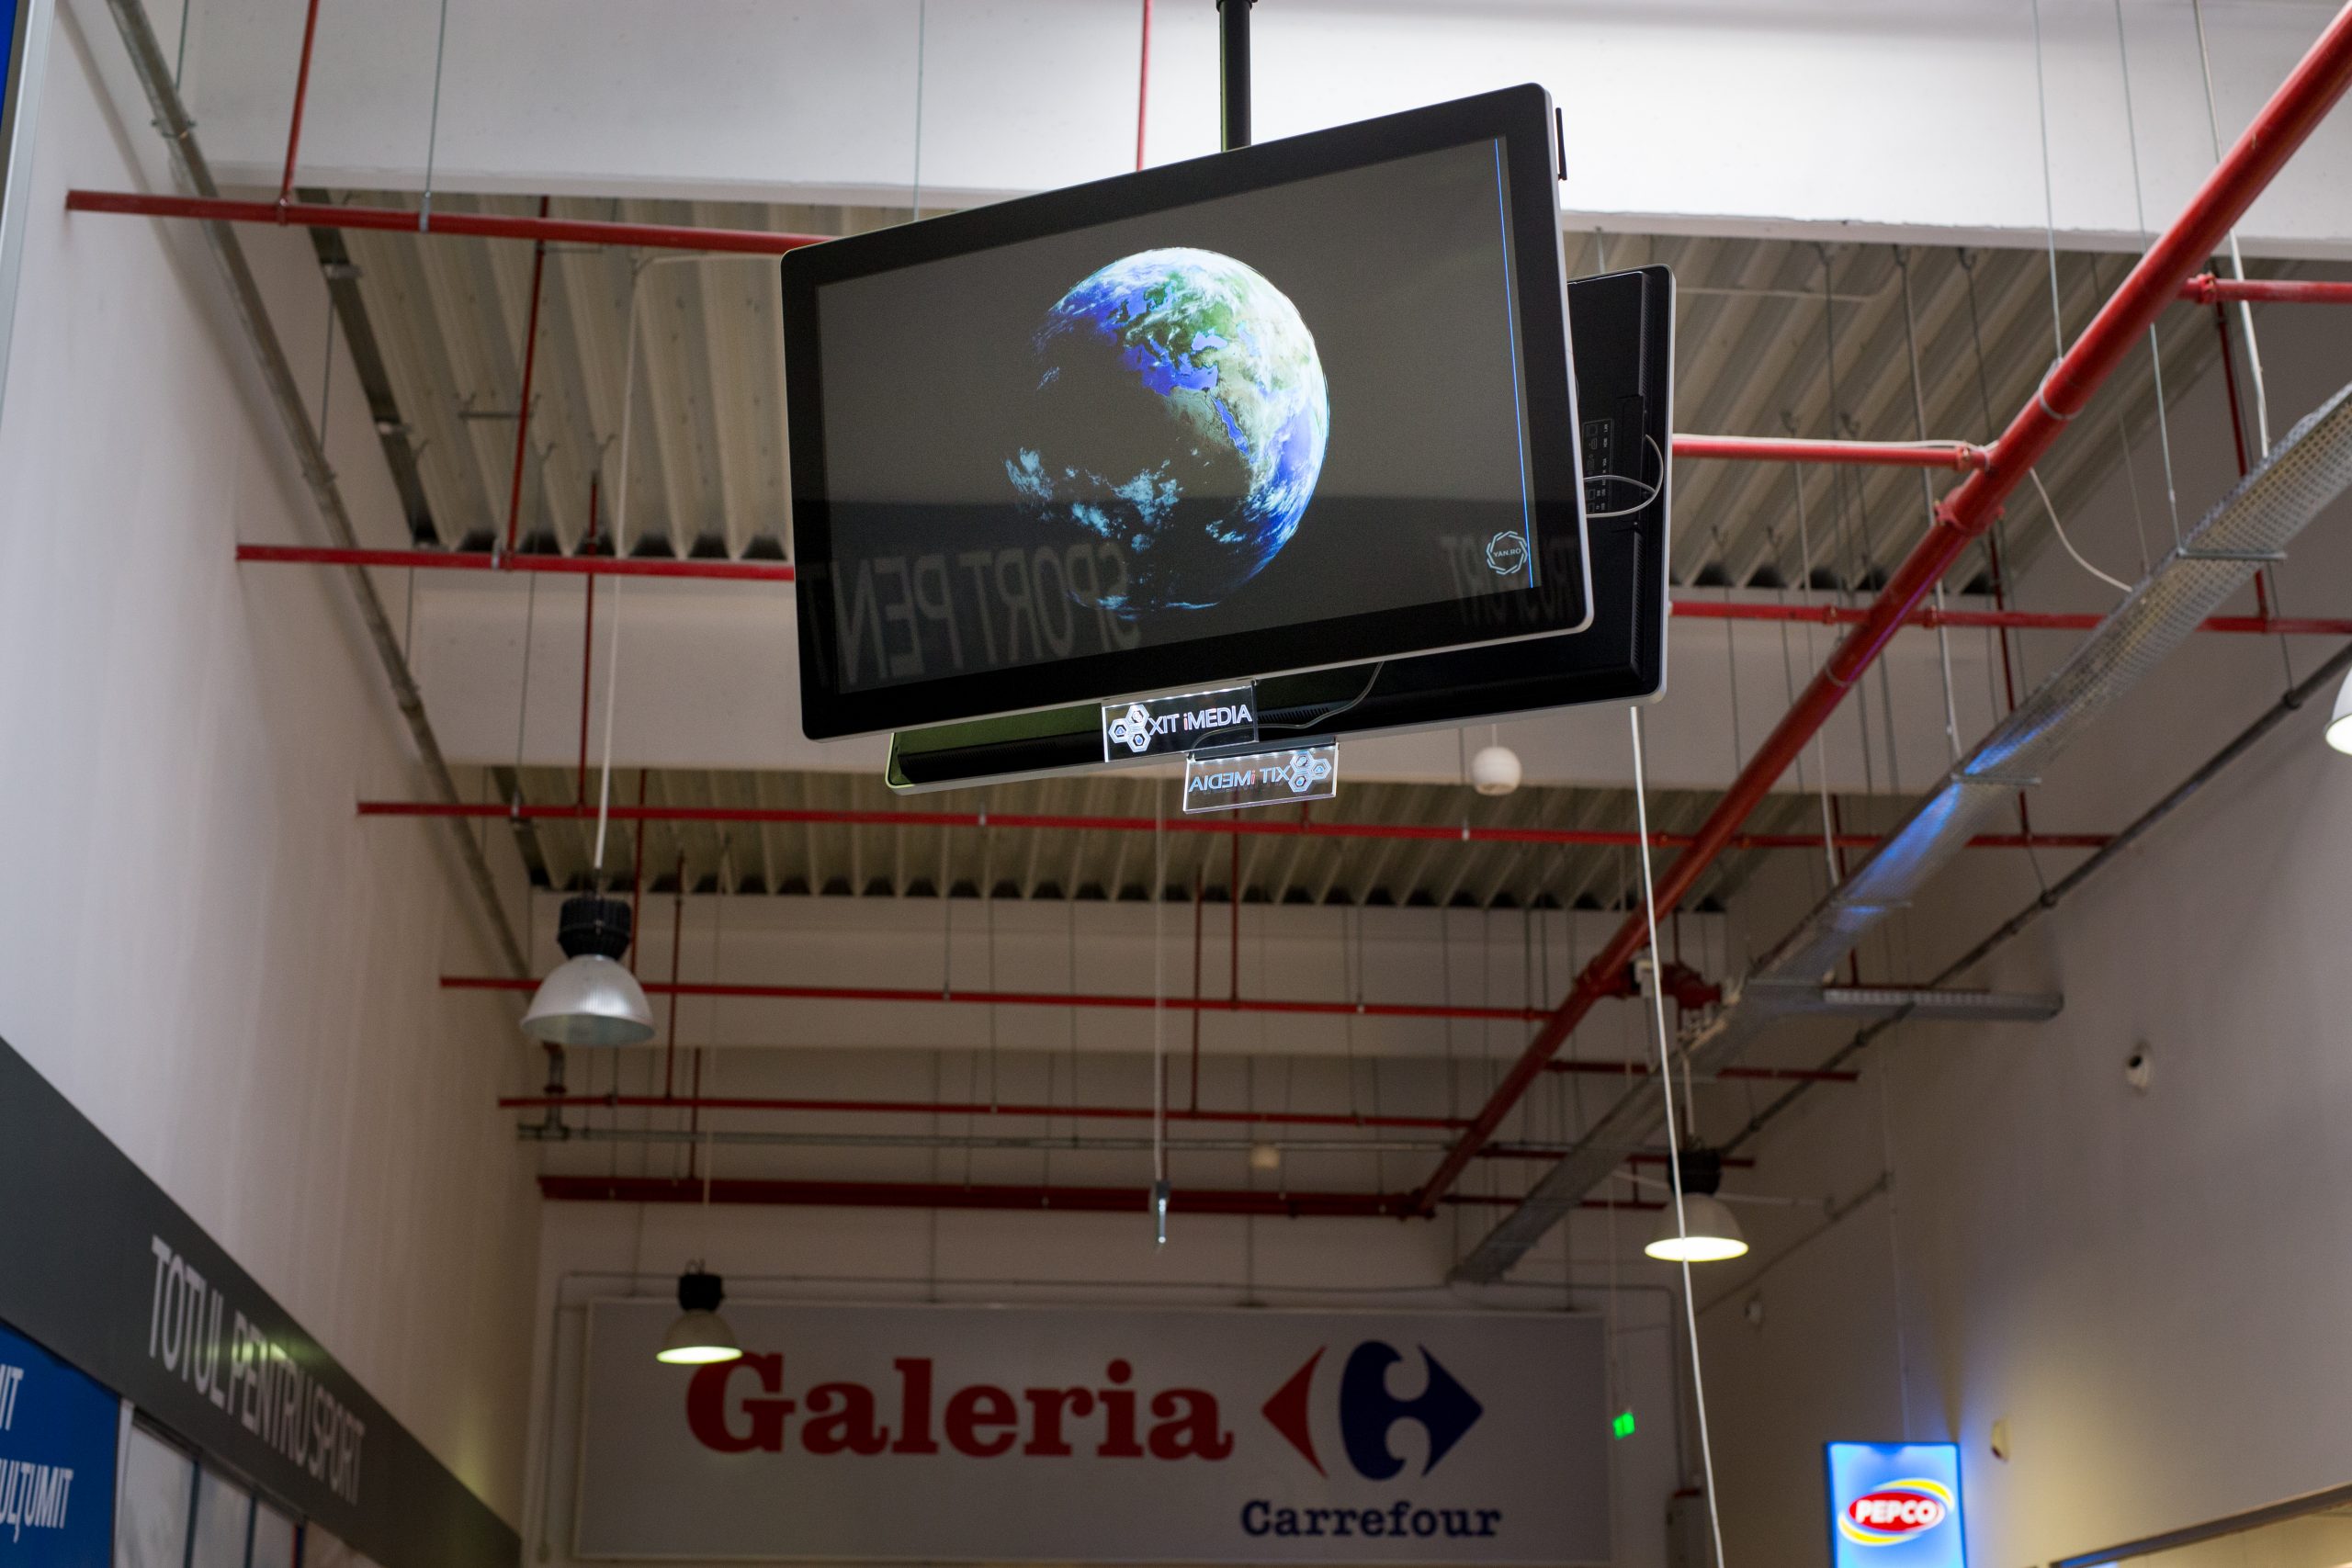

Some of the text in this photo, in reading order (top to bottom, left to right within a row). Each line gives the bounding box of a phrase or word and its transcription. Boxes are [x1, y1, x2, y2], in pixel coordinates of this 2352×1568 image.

[1493, 547, 1521, 558] YAN.RO
[1182, 704, 1252, 731] iMEDIA
[149, 1235, 366, 1506] TOTUL PENTRU SPORT
[685, 1352, 1234, 1461] Galeria
[1241, 1500, 1501, 1538] Carrefour
[1856, 1499, 1937, 1525] PEPCO
